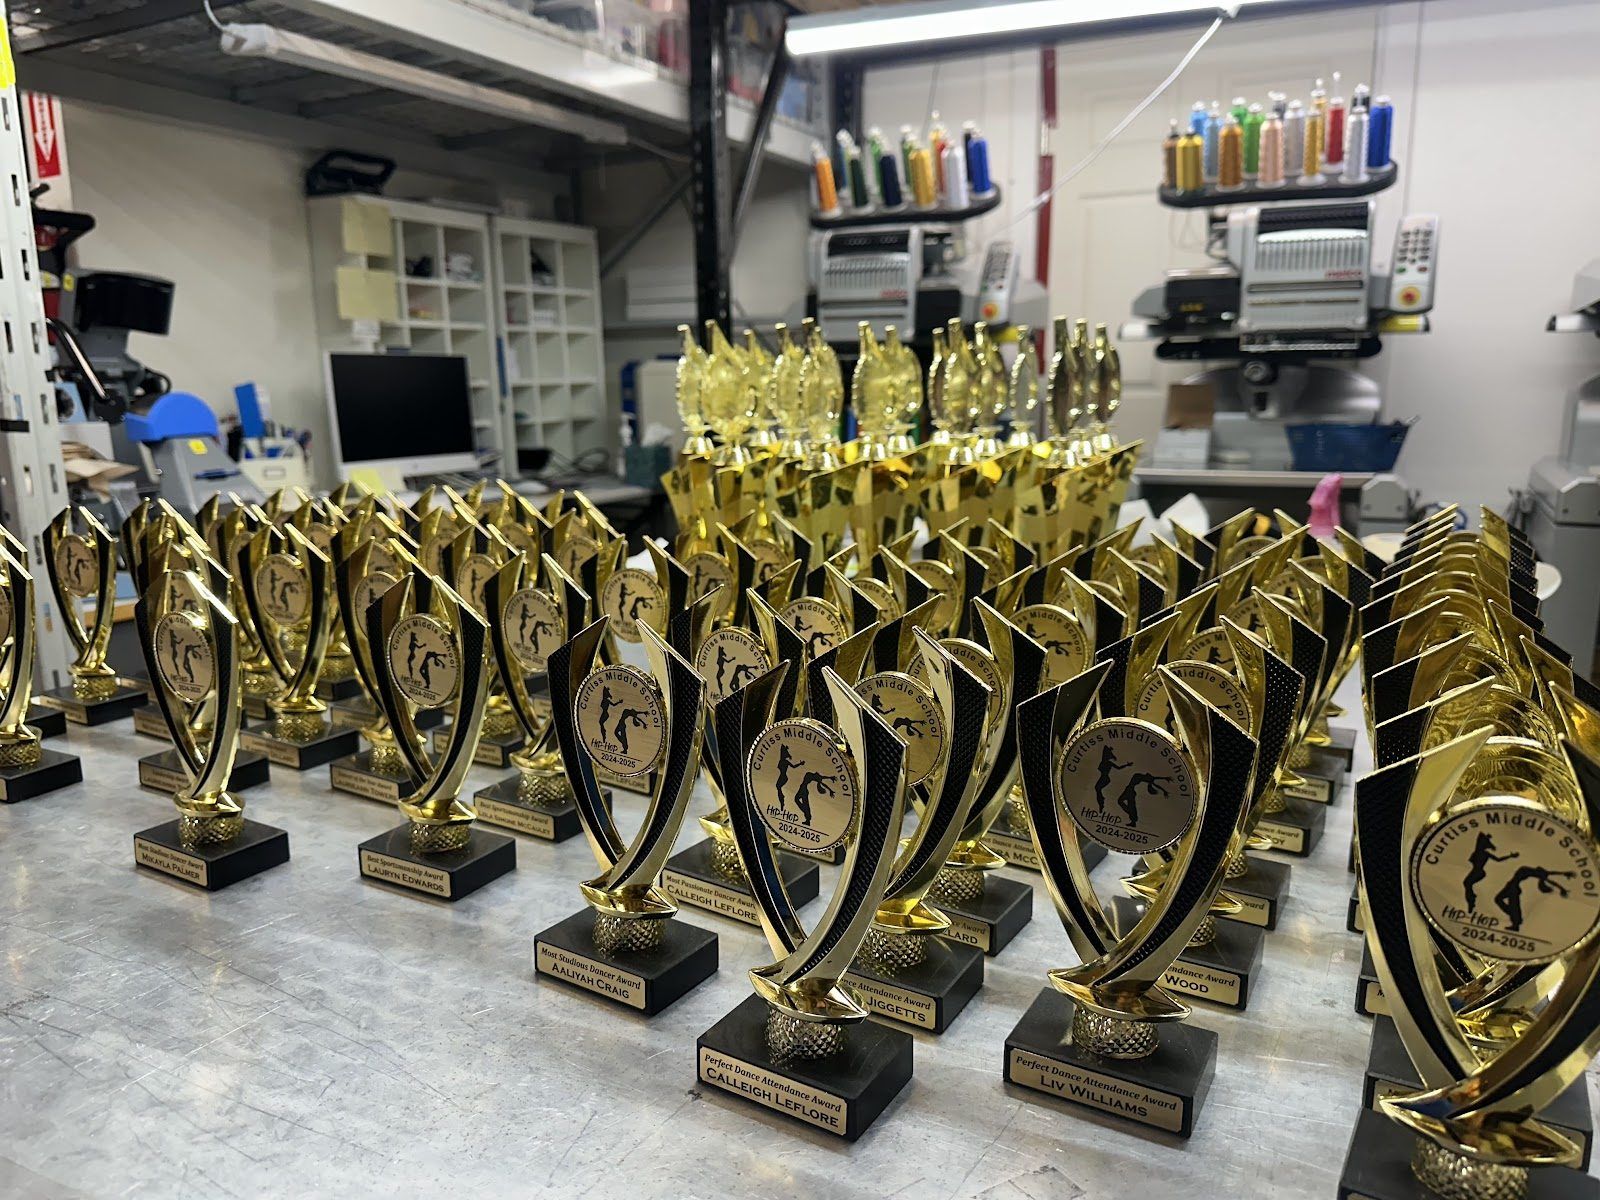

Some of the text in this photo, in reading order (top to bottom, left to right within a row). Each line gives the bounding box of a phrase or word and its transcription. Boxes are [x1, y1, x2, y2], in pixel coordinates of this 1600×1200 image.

[797, 603, 825, 616] Middle
[826, 614, 843, 642] Schoo
[1030, 611, 1083, 656] Middle School
[393, 620, 457, 669] Curtiss Middle School
[699, 632, 767, 675] Curtiss Middle Schoo
[1186, 638, 1212, 661] urtiss
[945, 646, 1000, 699] iddle School
[408, 686, 437, 701] 2024-2025
[580, 671, 661, 729] Curtiss Middle School
[1139, 669, 1247, 722] Curtis Middle School
[875, 679, 915, 698] Middle
[915, 694, 940, 739] School
[601, 752, 637, 769] 2024-2025
[753, 727, 852, 797] Curtiss Middle School
[1067, 728, 1192, 798] Curtiss Middle School
[492, 804, 530, 820] Sportsmanship
[531, 815, 549, 825] Award
[778, 822, 821, 843] 2024-2025
[1095, 824, 1149, 845] 2024-2025
[1277, 829, 1300, 839] Award
[142, 853, 200, 880] MIKAYLA PALMER
[187, 860, 204, 871] Award
[367, 855, 444, 882] Best Sportsmanship Award
[1425, 811, 1600, 898] Curtiss Middle School
[368, 864, 445, 892] LAURYN EDWARDS
[666, 875, 757, 909] Most Passionate Dancer Awar
[667, 884, 712, 906] CALLEIGH
[1244, 900, 1265, 910] ward
[961, 922, 986, 935] Award
[1461, 926, 1537, 953] 2024-2025
[541, 947, 641, 990] Most Studious Dancer Award
[551, 962, 630, 999] AALIYAH CRAIG
[1167, 966, 1235, 987] endance Award
[858, 982, 902, 1001] Attendance
[903, 996, 931, 1010] Award
[1164, 973, 1209, 993] WOOD
[867, 996, 926, 1021] JIGGETTS
[704, 1053, 842, 1113] Perfect Dance Attendance Award
[1016, 1056, 1177, 1111] Perfect Dance Attendance Award
[1040, 1075, 1148, 1117] LIV WILLIAMS
[706, 1067, 839, 1128] CALLEIGH LEFLORE
